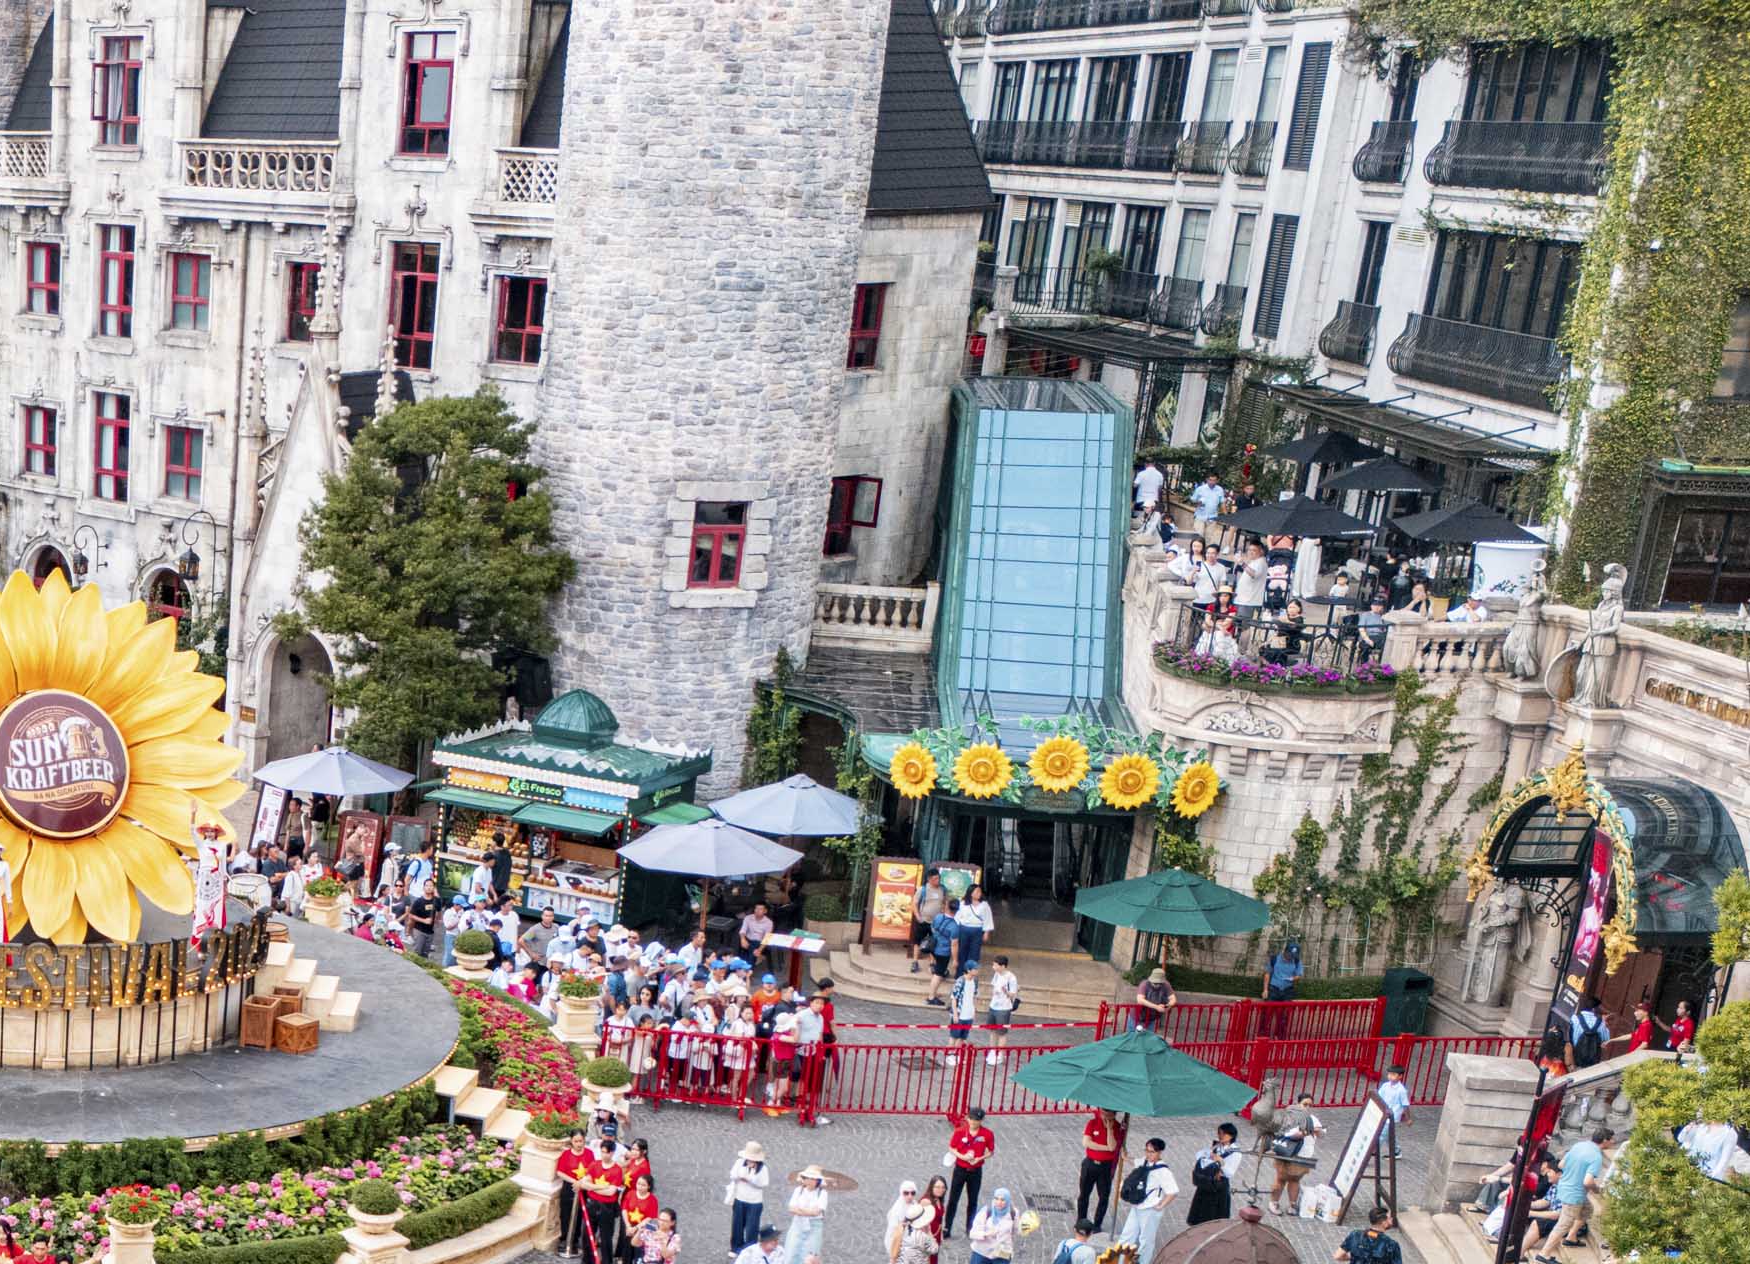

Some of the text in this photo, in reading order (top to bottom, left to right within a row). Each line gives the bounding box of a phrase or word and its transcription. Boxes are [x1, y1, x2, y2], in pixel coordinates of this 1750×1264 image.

[10, 732, 63, 768] SUN
[5, 758, 115, 791] KRAFTBEER
[530, 784, 562, 798] Fresco
